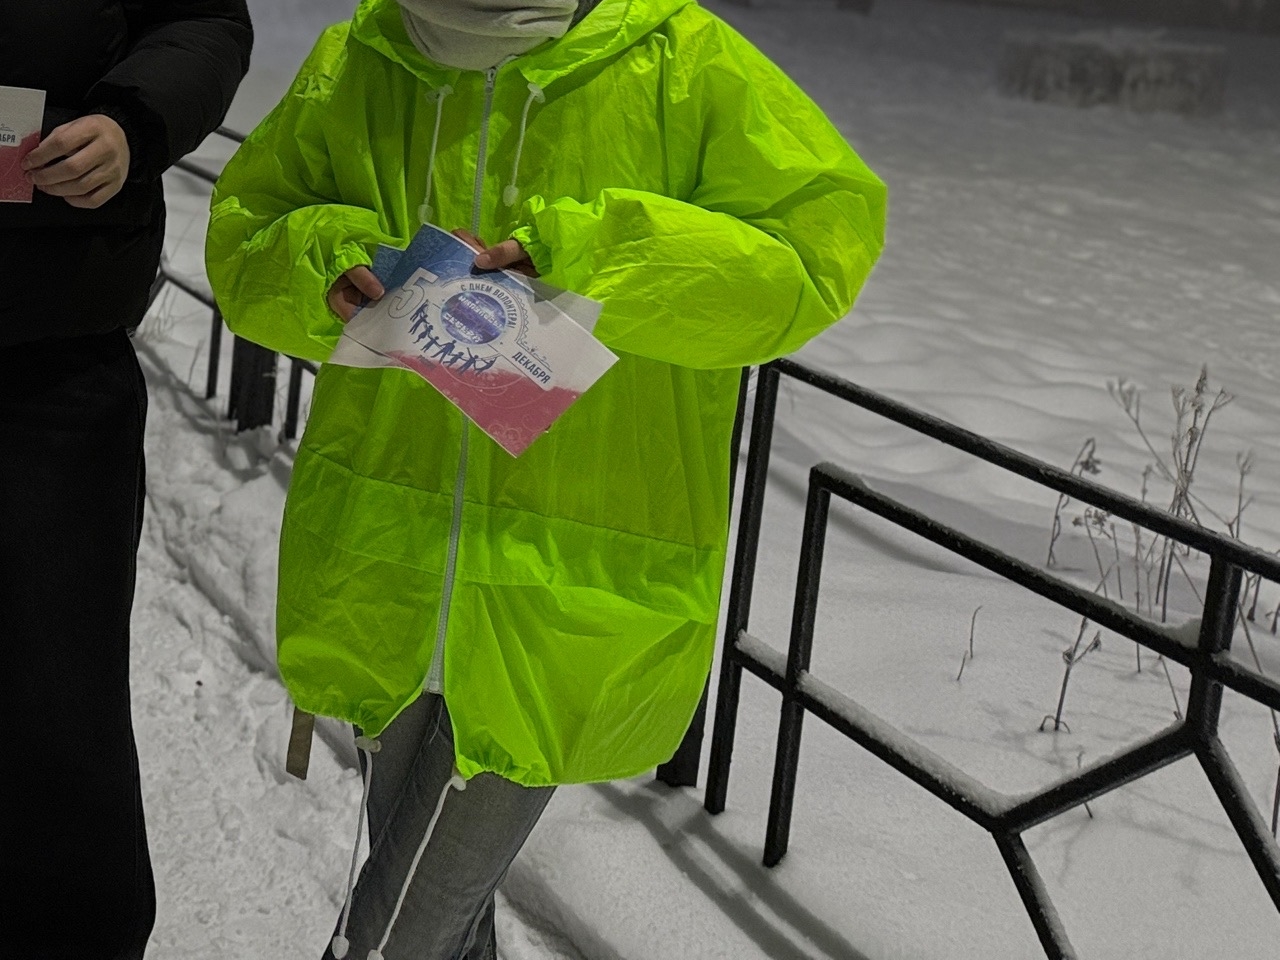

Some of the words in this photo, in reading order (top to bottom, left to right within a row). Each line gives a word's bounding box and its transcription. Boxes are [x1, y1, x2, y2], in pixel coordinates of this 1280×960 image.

[388, 267, 440, 320] 5
[469, 283, 492, 293] ДНЕМ
[511, 350, 552, 386] ДЕКАБРЯ
